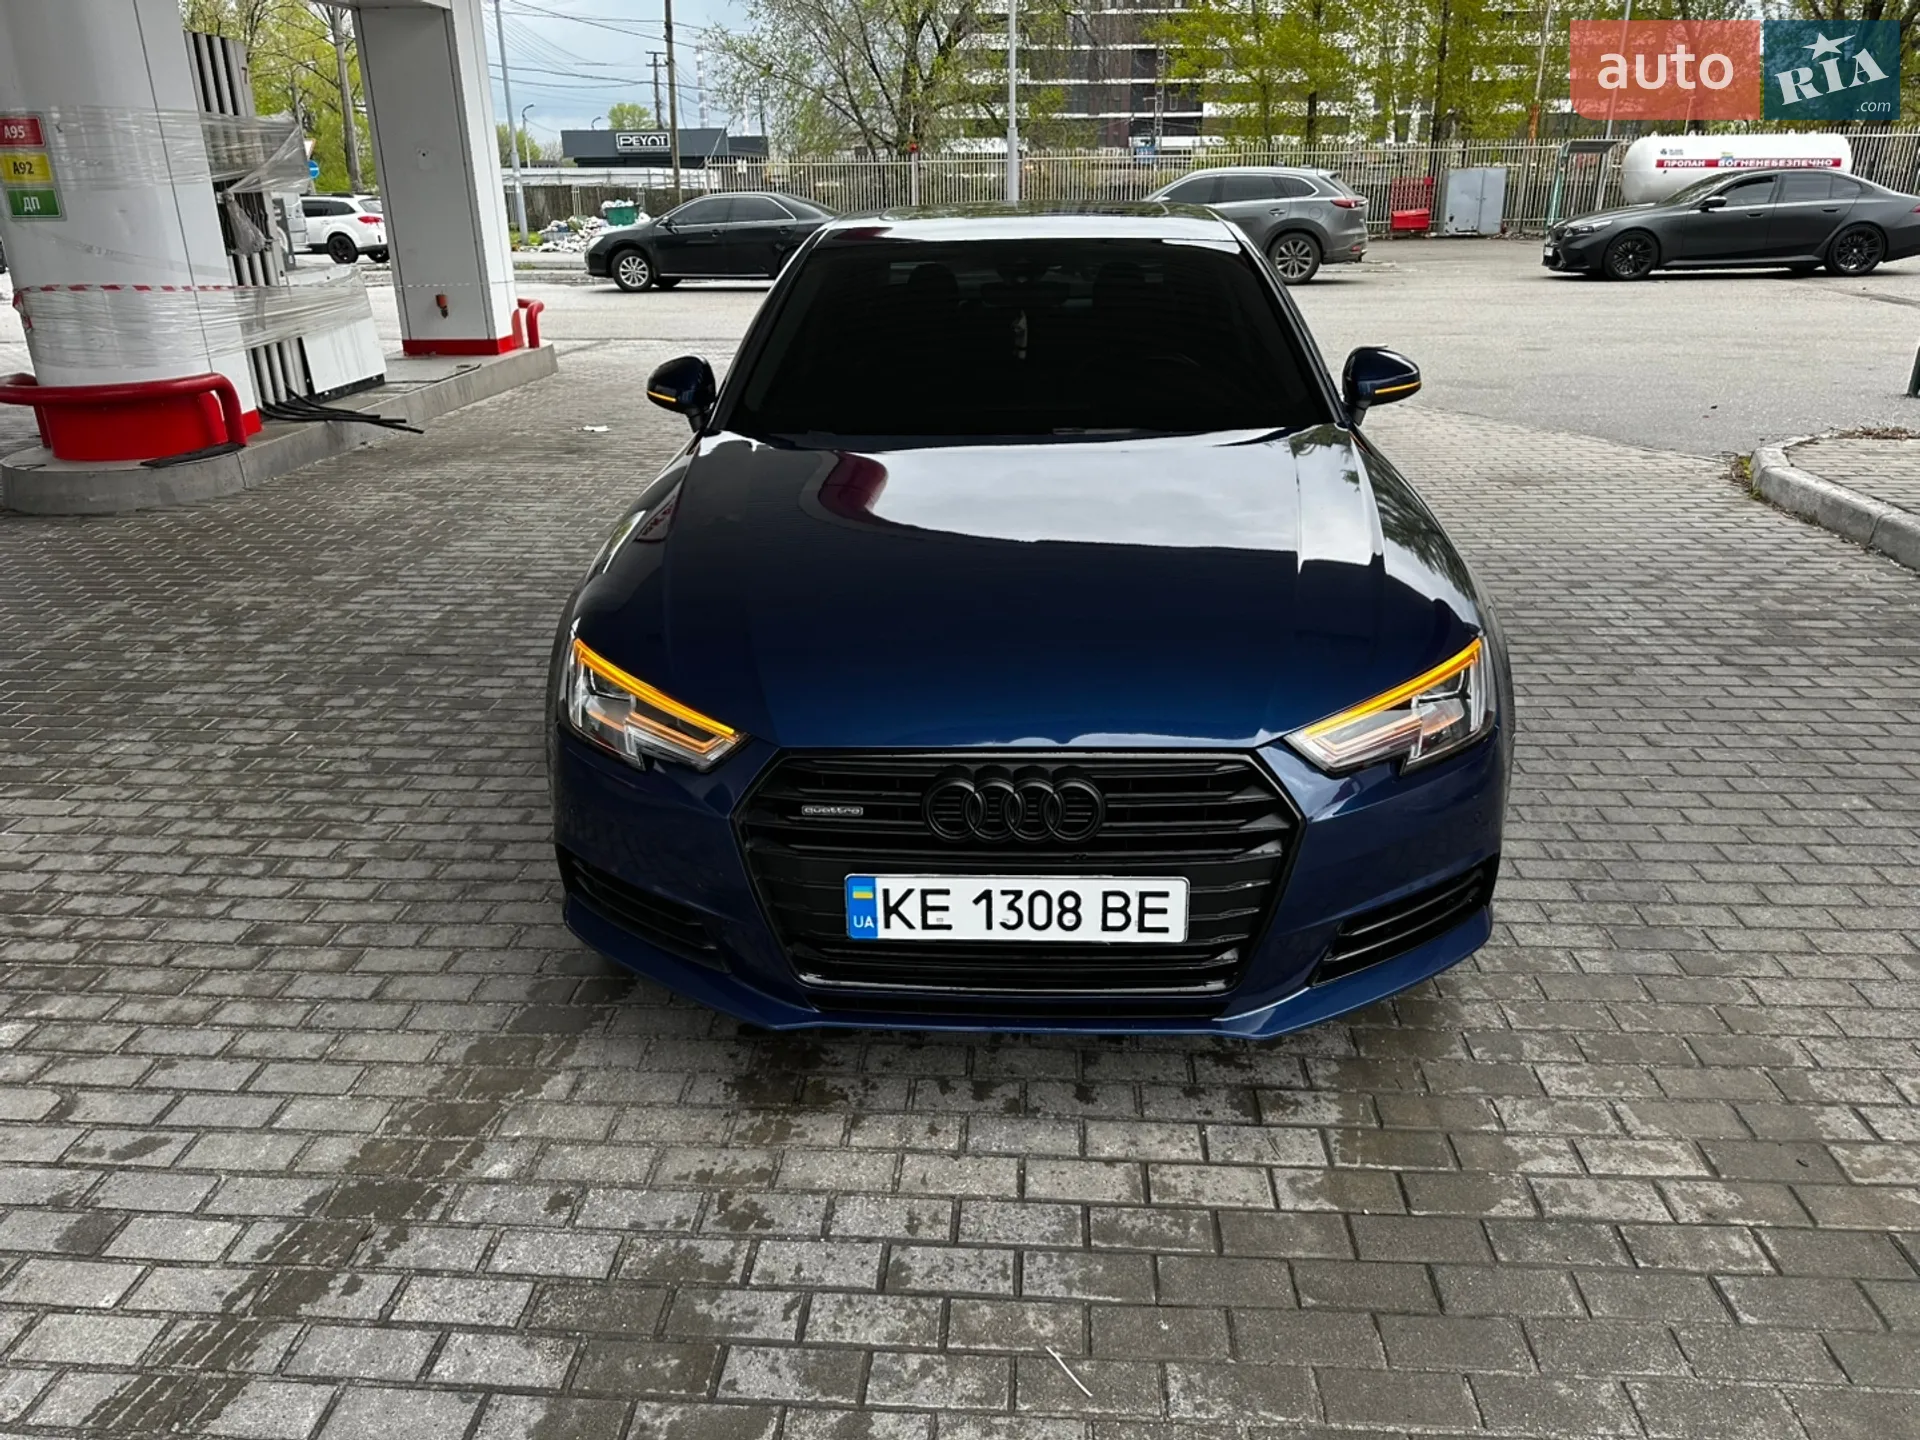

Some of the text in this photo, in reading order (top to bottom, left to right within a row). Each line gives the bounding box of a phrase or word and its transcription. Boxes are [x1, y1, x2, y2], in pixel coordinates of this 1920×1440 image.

[1663, 159, 1706, 167] ПРОПАН
[23, 196, 41, 212] ДП
[804, 806, 861, 815] quattro
[882, 888, 1170, 933] KE 1308 BE
[853, 915, 874, 928] UA
